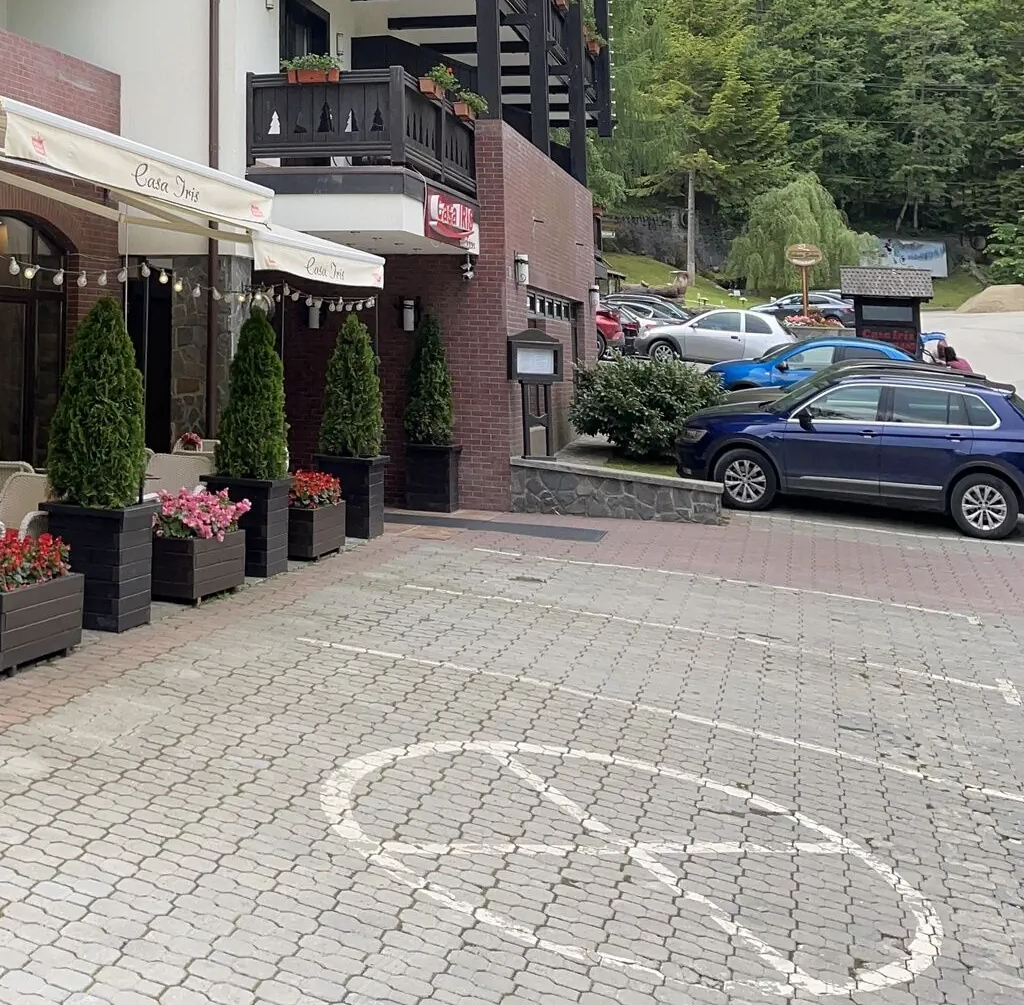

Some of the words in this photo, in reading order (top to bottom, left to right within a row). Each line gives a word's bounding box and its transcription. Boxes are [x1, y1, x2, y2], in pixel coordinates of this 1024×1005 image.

[131, 163, 169, 194] Casa
[173, 175, 200, 203] Iris
[436, 195, 458, 227] Casa
[305, 257, 328, 277] Casa
